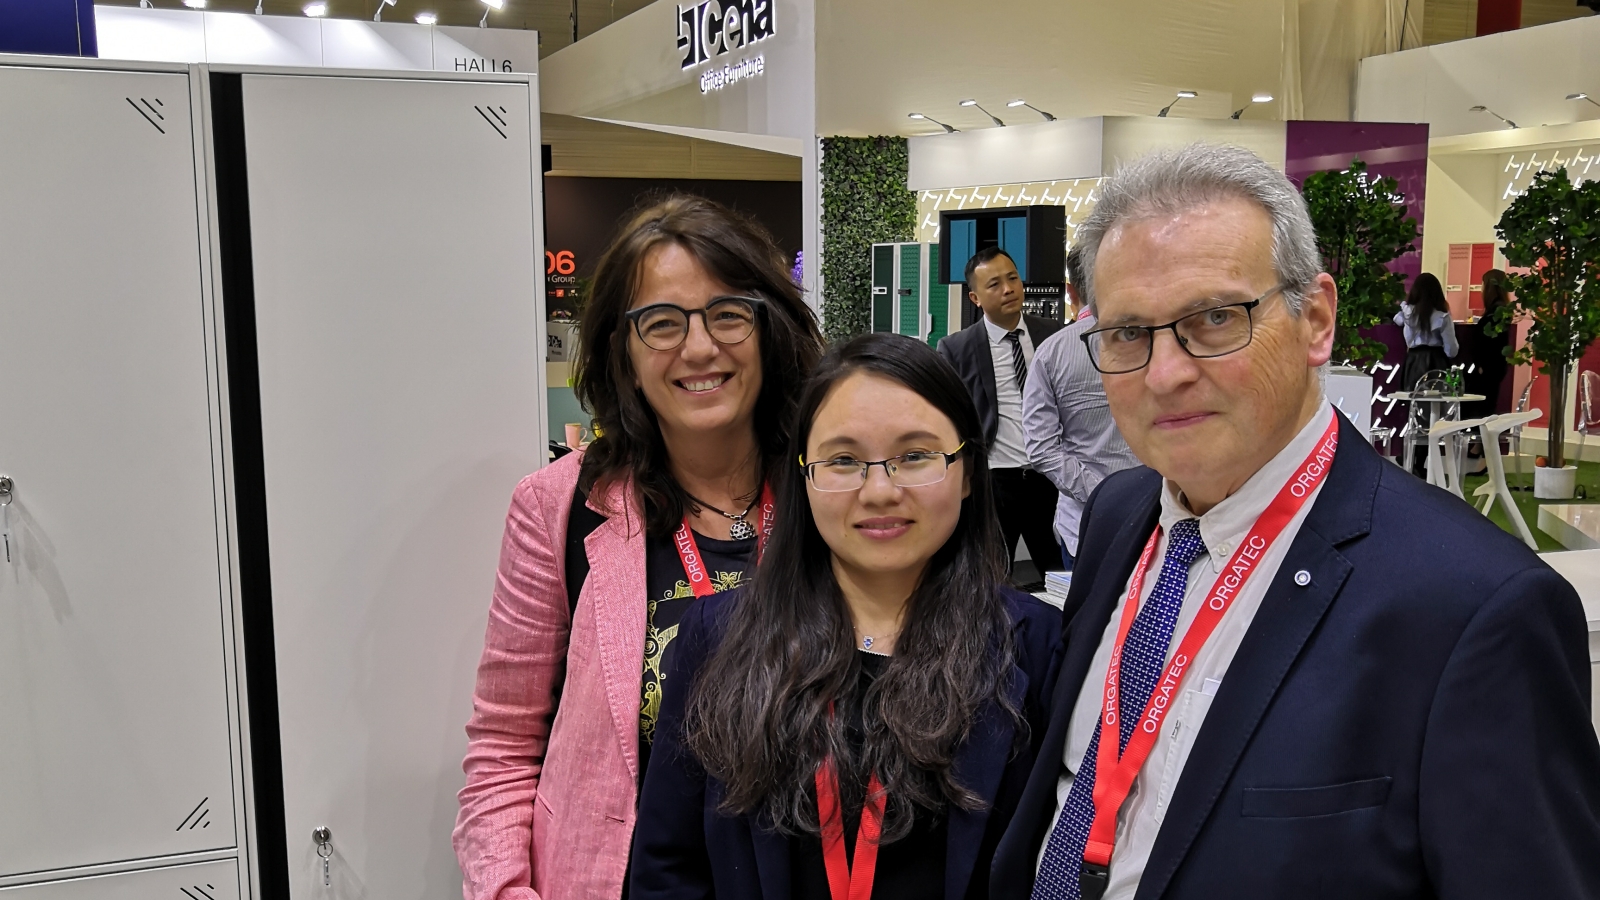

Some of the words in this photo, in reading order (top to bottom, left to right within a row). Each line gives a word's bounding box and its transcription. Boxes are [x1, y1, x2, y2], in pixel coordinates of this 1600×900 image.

[700, 69, 724, 94] Office
[724, 55, 765, 86] Furniture
[551, 275, 576, 285] Group
[1290, 431, 1339, 498] ORGATEC
[675, 522, 704, 582] ORGATEC
[1209, 535, 1266, 611] ORGATEC
[1104, 644, 1123, 726] ORGATEC
[1142, 653, 1188, 733] ORGATEC
